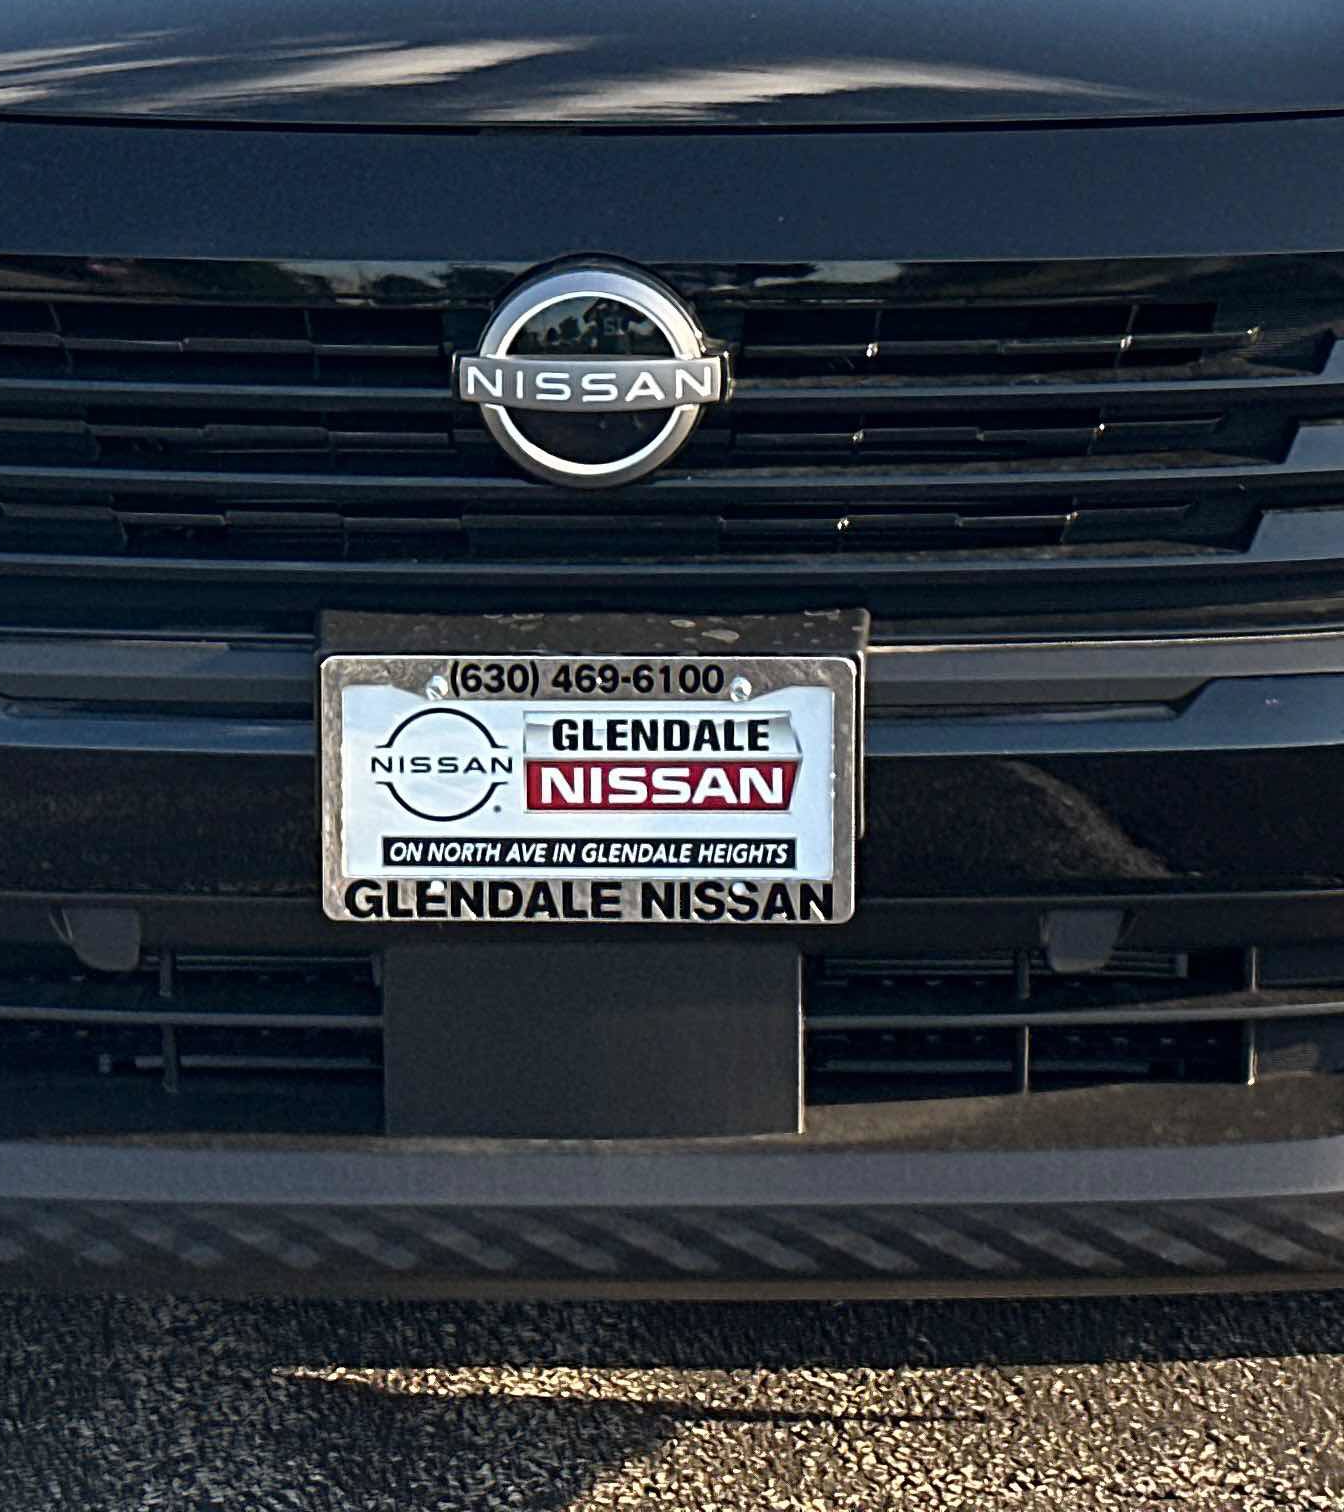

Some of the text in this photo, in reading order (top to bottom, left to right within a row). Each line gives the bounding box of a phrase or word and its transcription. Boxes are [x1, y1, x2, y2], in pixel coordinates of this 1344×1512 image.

[466, 366, 712, 402] NISSAN
[450, 660, 725, 697] (630) 469-6100
[552, 718, 770, 752] GLENDALE
[370, 756, 513, 774] NISSAN
[541, 766, 783, 805] NISSAN
[389, 842, 788, 864] ON NORTH AVE IN GLENDALE HEIGHTS
[344, 878, 833, 920] GLENDALE NISSAN
